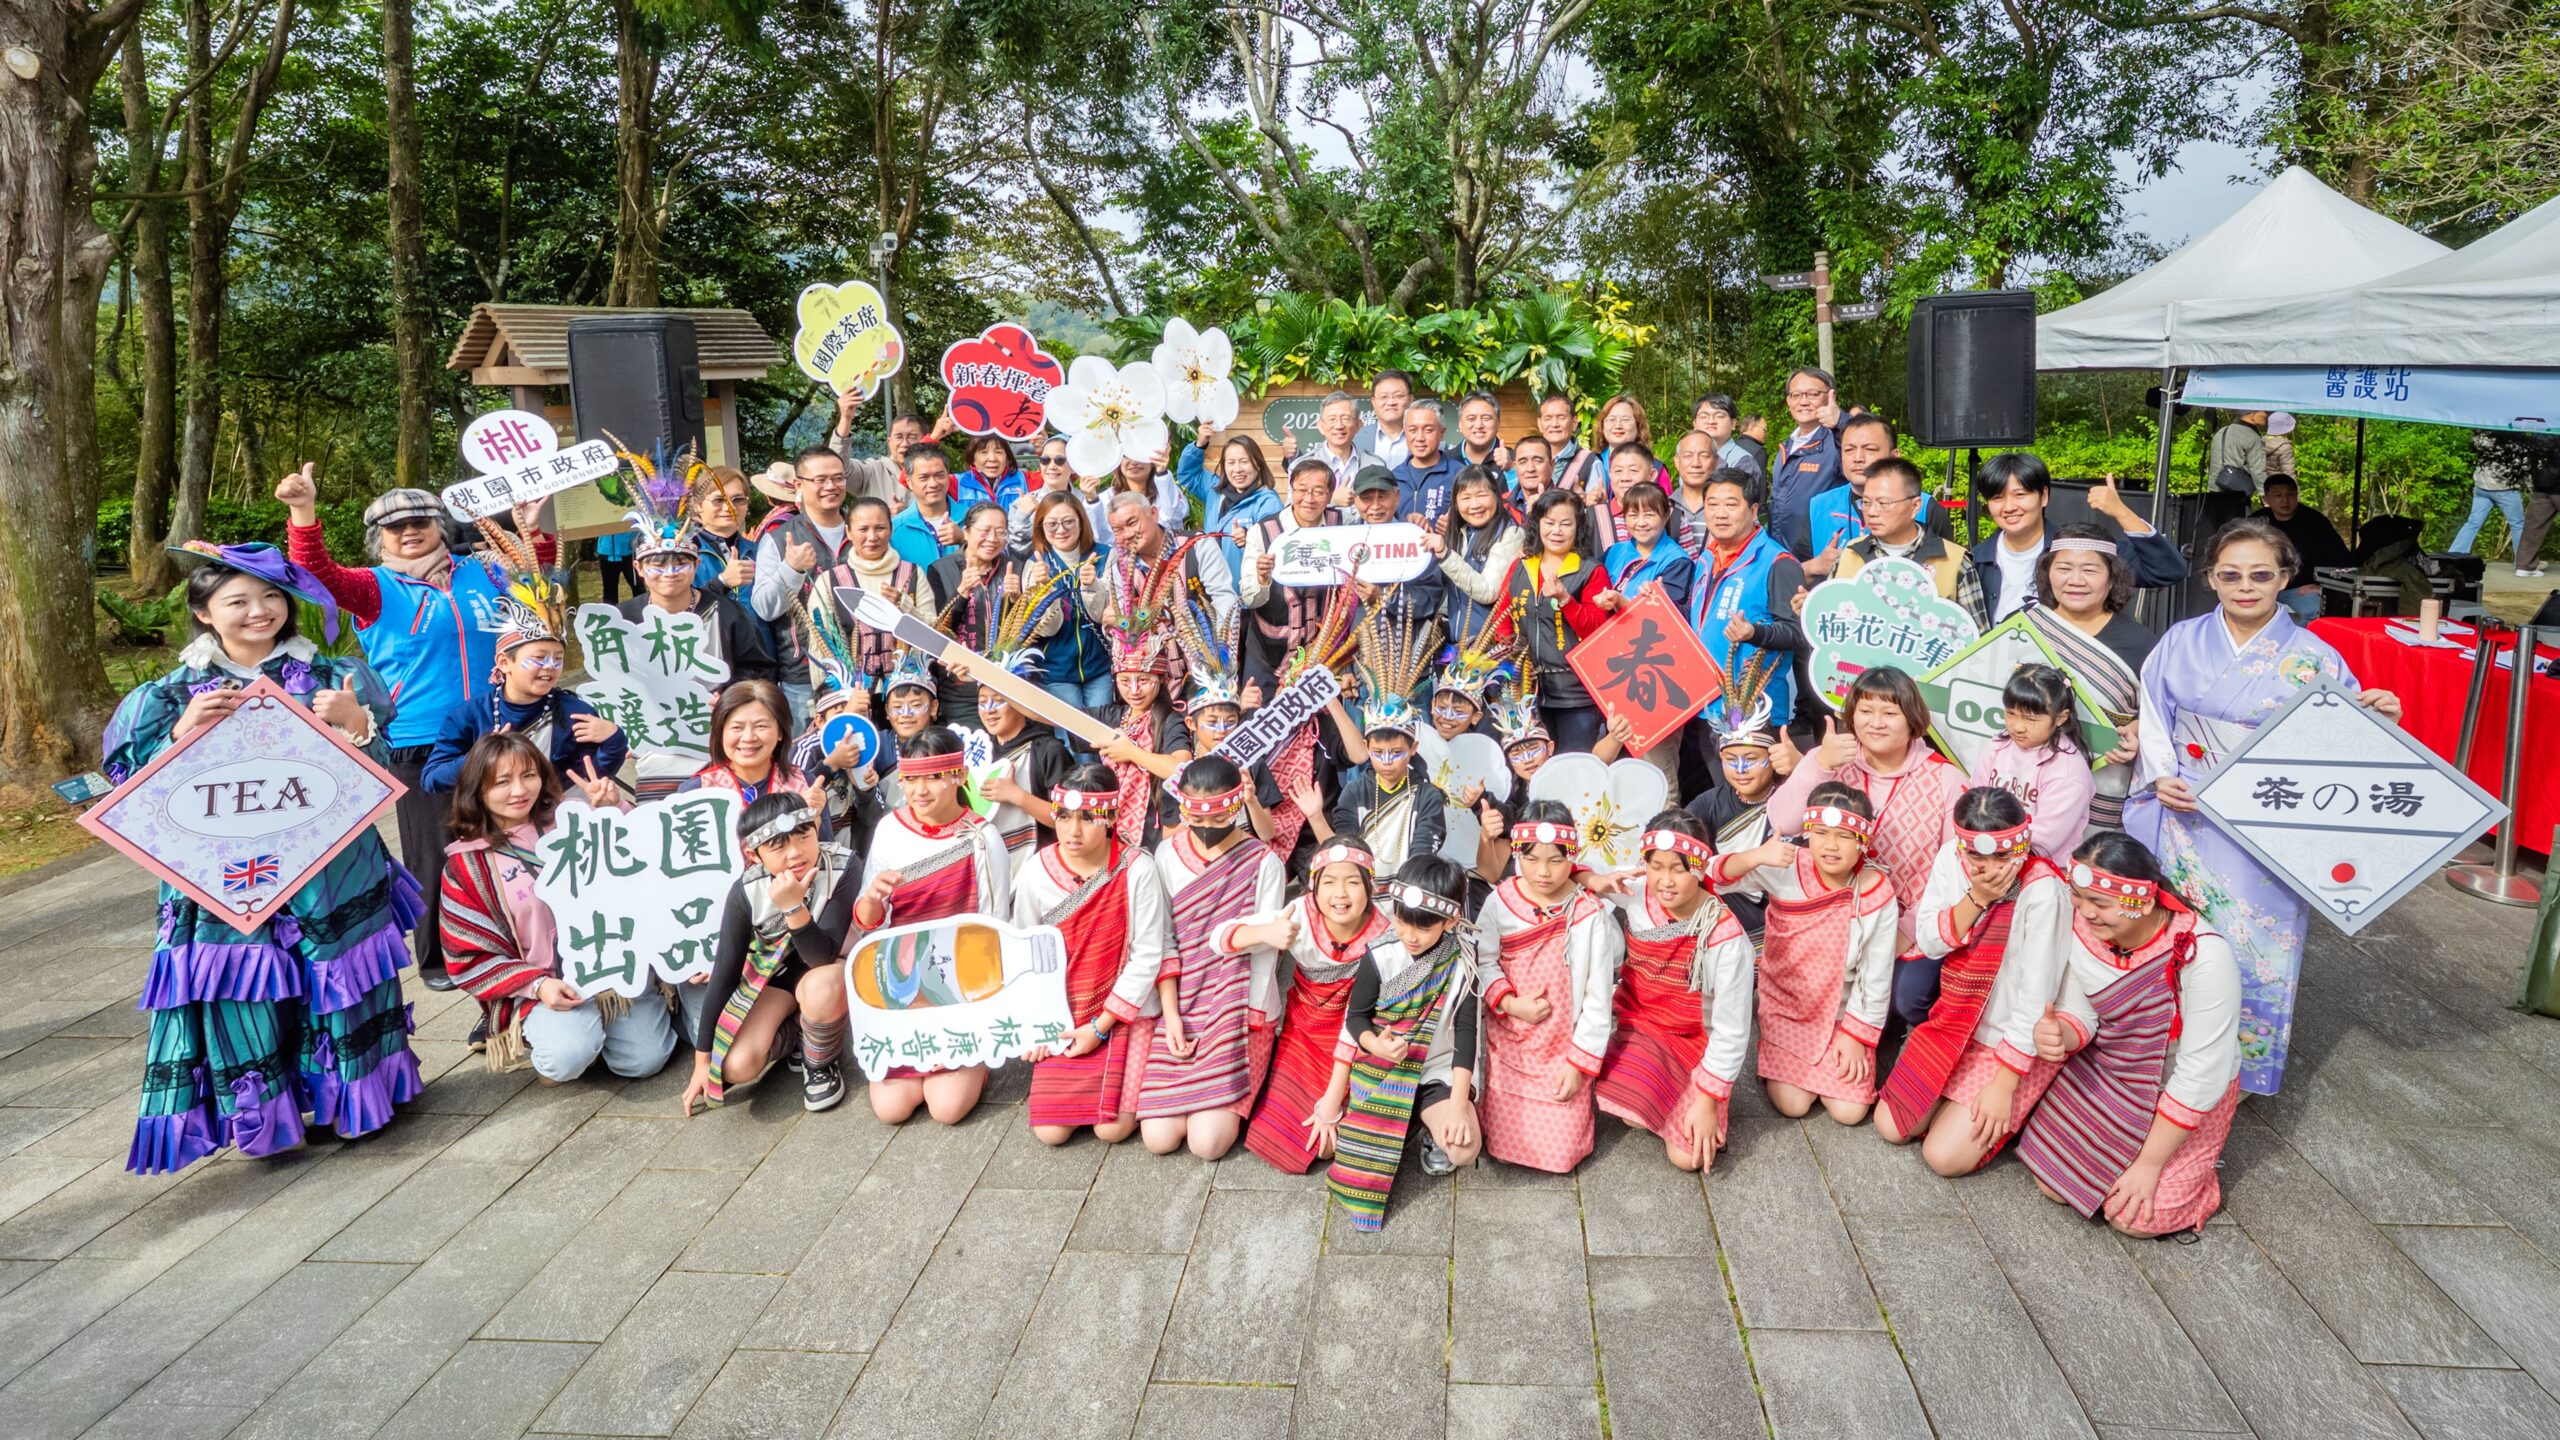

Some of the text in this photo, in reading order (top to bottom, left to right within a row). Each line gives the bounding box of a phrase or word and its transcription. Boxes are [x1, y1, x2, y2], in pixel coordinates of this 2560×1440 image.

[812, 304, 878, 374] 國際茶席
[954, 364, 1051, 402] 新春揮毫
[2326, 365, 2411, 402] 醫護站
[1282, 412, 1321, 430] 202
[449, 444, 607, 508] 桃園市政府
[461, 496, 514, 518] TOYUAN
[516, 487, 540, 502] CITY
[545, 462, 614, 490] GOVERNMENT
[1373, 542, 1419, 560] TINA
[585, 613, 721, 676] 角板
[1597, 618, 1691, 713] 春
[1817, 613, 1955, 669] 梅花市集
[586, 687, 710, 753] 釀造
[959, 733, 986, 767] 梅
[193, 776, 314, 818] TEA
[2252, 777, 2425, 818] 茶の湯
[545, 798, 732, 898] 桃園
[569, 897, 721, 988] 出品
[860, 1016, 1067, 1073] 角板康普茶
